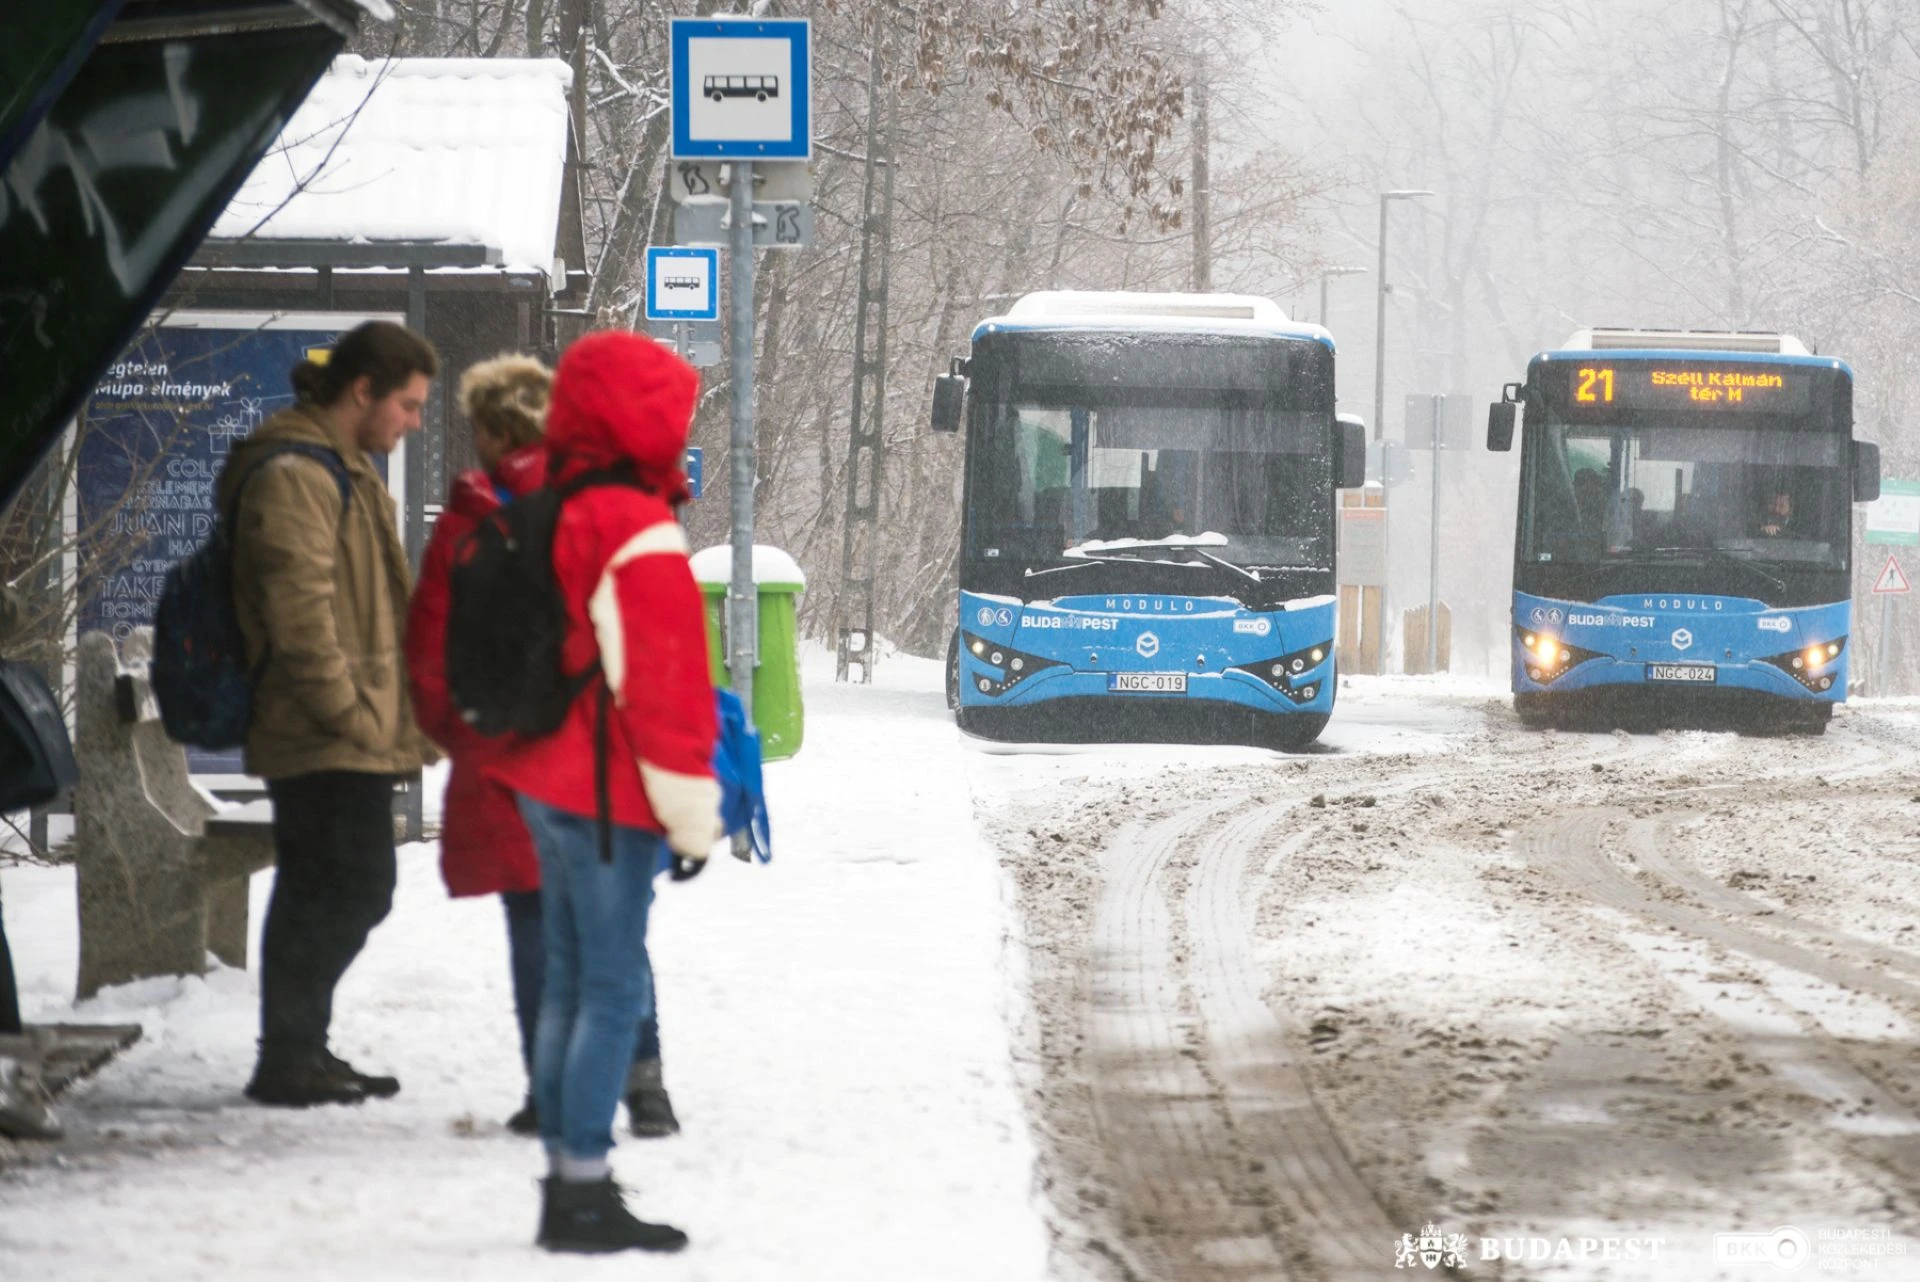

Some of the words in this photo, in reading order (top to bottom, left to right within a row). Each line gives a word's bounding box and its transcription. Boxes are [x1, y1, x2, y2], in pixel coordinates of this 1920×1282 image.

[1577, 368, 1614, 401] 21
[1651, 370, 1703, 386] Széll
[1708, 371, 1783, 387] Kálmán
[1690, 386, 1722, 402] tér
[1728, 387, 1743, 401] M
[1105, 599, 1194, 612] MODULO
[1643, 599, 1723, 611] MODULO
[1655, 667, 1713, 680] NGC-024
[1119, 675, 1183, 690] NGC-019
